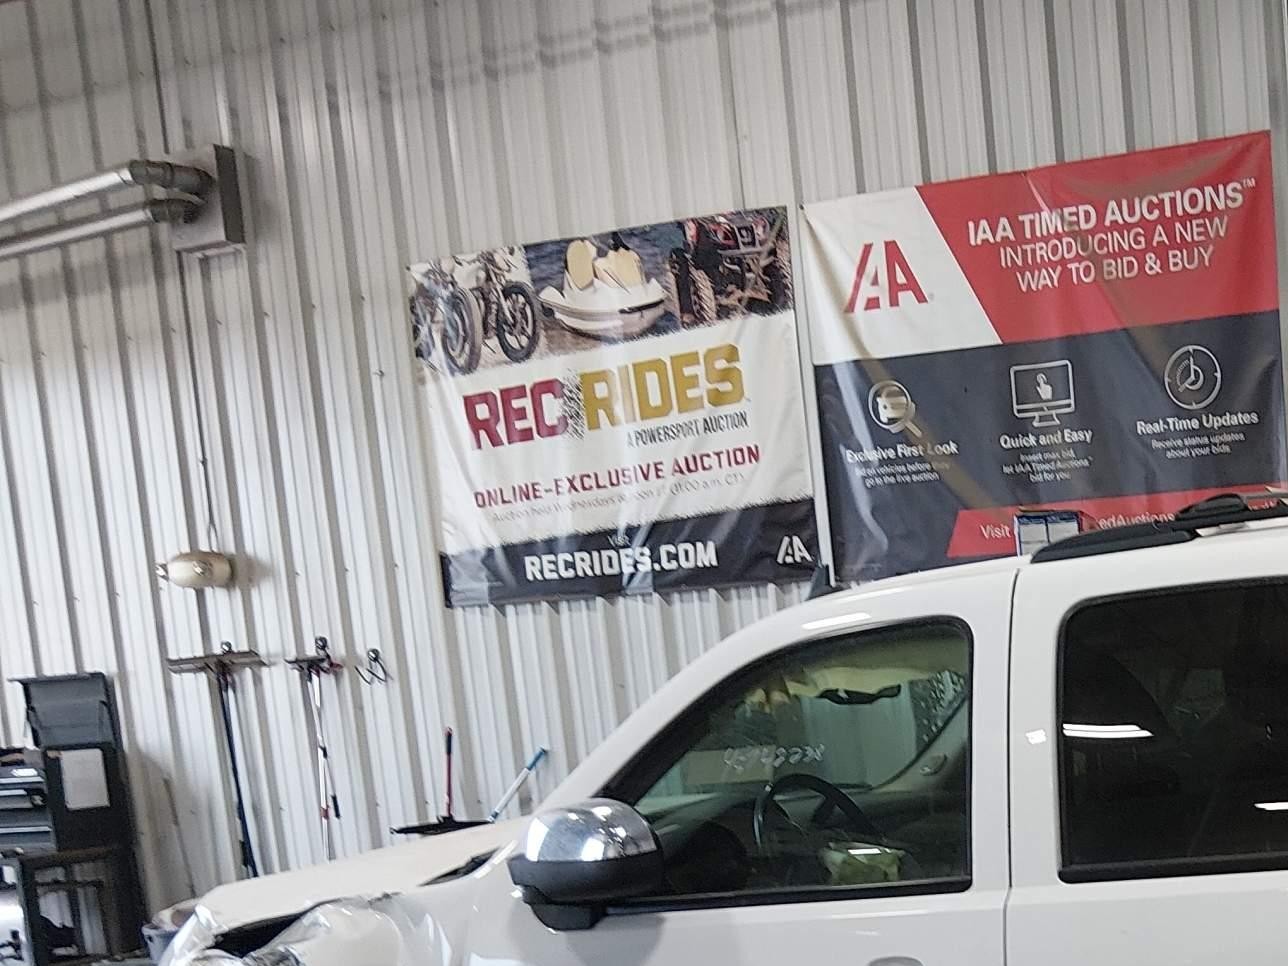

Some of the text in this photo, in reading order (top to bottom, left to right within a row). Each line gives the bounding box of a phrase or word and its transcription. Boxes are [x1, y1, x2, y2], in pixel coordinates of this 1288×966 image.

[968, 219, 1015, 246] IAA
[1018, 204, 1097, 239] TIMED
[1000, 216, 1228, 268] INTRODUCING A NEW
[1016, 244, 1214, 292] WAY TO BID & BUY
[462, 344, 745, 450] REC RIDES
[634, 419, 701, 448] POWERSPORT
[702, 411, 749, 434] AUCTION
[1000, 429, 1092, 450] Quick and Easy
[1136, 412, 1259, 435] Real-Time Updates
[846, 440, 960, 464] Exclusive First Look
[474, 460, 664, 508] ONLINE-EXCLUSIVE
[671, 445, 760, 476] AUCTION
[981, 524, 1010, 539] Visit
[524, 541, 718, 581] RECRIDES.COM
